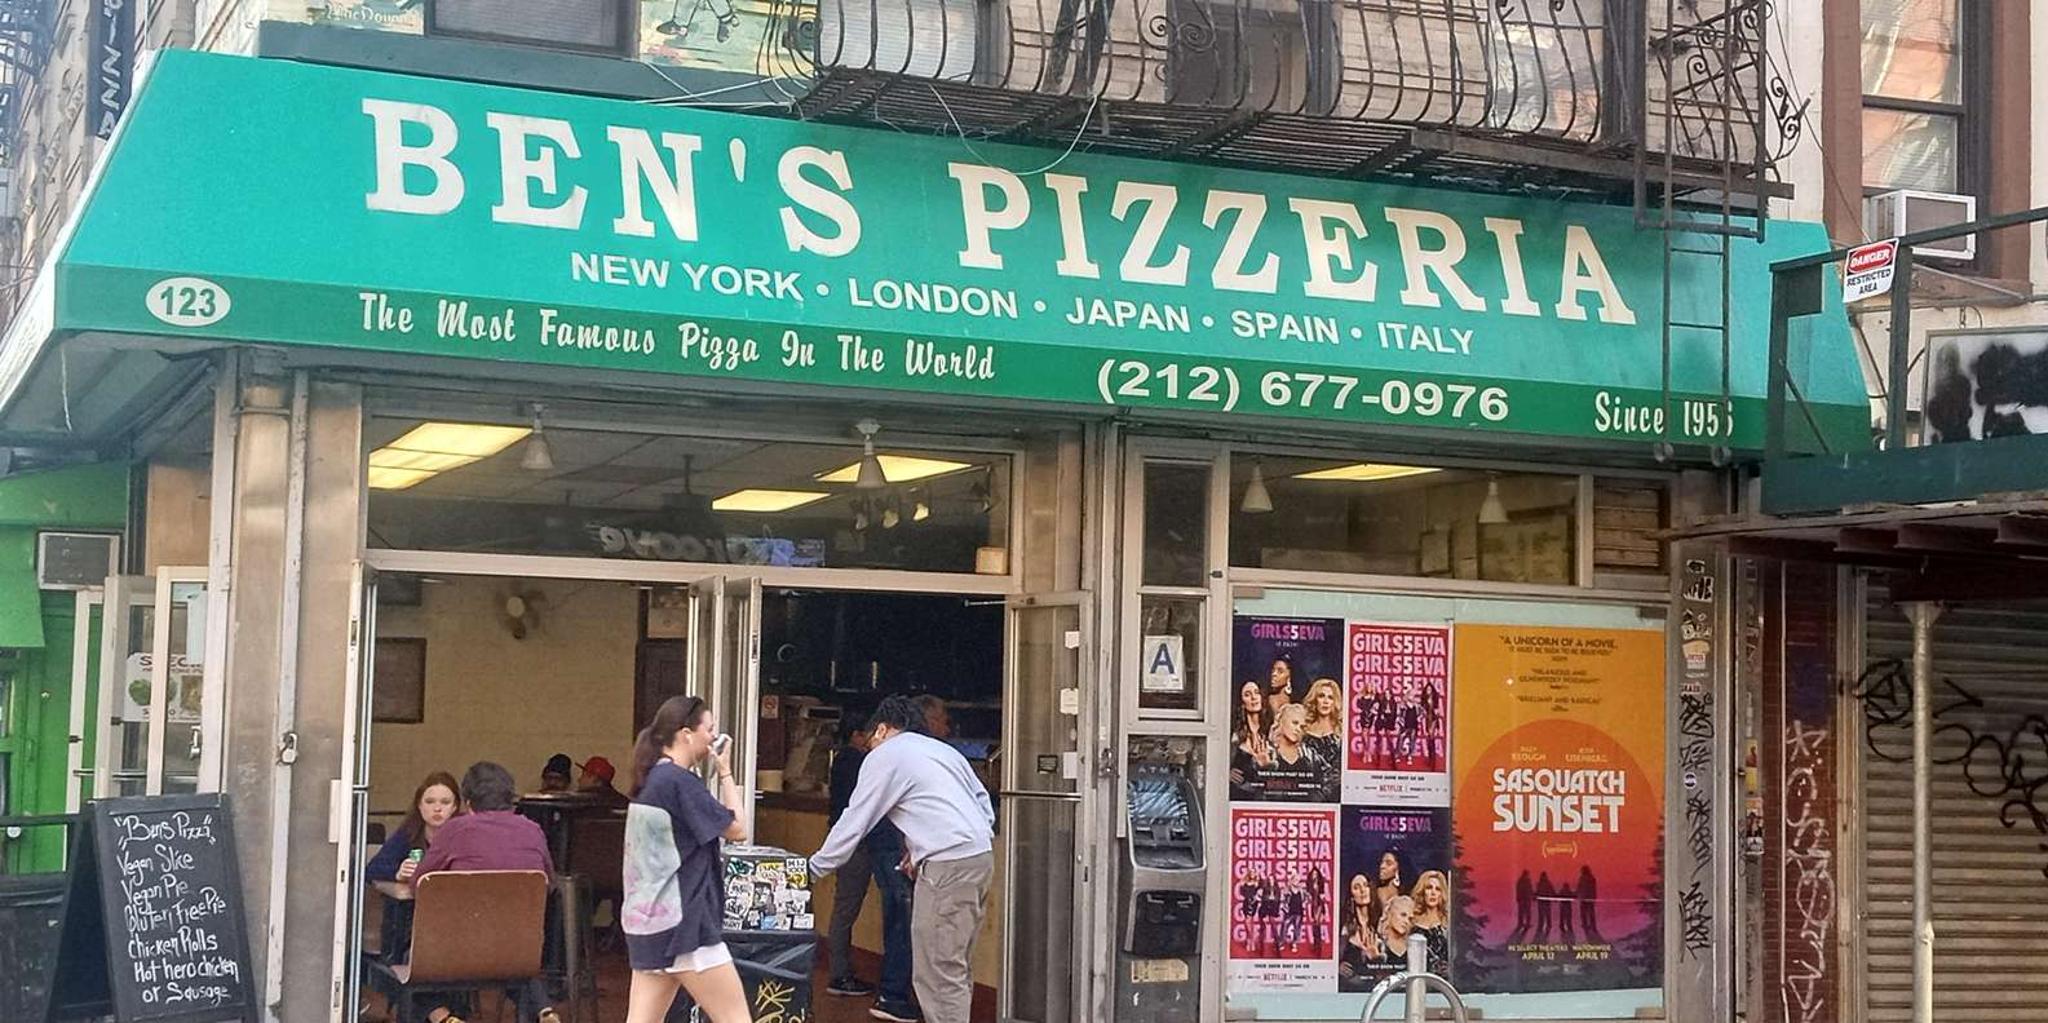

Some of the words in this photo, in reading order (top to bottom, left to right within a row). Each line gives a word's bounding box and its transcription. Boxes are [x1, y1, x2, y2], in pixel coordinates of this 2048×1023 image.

[362, 98, 861, 257] BEN'S
[948, 162, 1635, 325] PIZZERIA
[1849, 247, 1891, 268] DANGER
[1846, 269, 1892, 287] RESTRICTED
[1859, 282, 1878, 295] AREA
[160, 285, 217, 318] 123
[570, 250, 669, 288] NEW
[682, 261, 803, 301] YORK
[848, 278, 1019, 320] LONDON
[1066, 297, 1191, 333] JAPAN
[1232, 309, 1341, 345] SPAIN
[1376, 320, 1475, 356] ITALY
[359, 292, 414, 333] The
[436, 299, 516, 343] Most
[540, 308, 656, 355] Famous
[678, 321, 760, 371] Pizza
[781, 330, 816, 368] In
[838, 334, 885, 372] The
[905, 338, 996, 381] World
[1098, 358, 1241, 412] (212)
[1260, 369, 1510, 422] 677-0976
[1594, 391, 1664, 434] Since
[1251, 623, 1326, 641] GIRLS5EVA
[1352, 632, 1446, 656] GIRLS5EVA
[1514, 636, 1558, 647] UNICORN
[1561, 638, 1574, 647] OF
[1576, 638, 1583, 646] A
[1149, 642, 1176, 675] A
[1352, 653, 1446, 676] GIRLS5EVA
[1492, 767, 1626, 795] SASQUATCH
[1360, 815, 1432, 832] GIRLS5EVA
[1492, 795, 1626, 833] SUNSET
[1235, 818, 1332, 839] GIRLS5EVA
[1234, 838, 1332, 860] GIRLS5EVA
[116, 850, 154, 886] Vegan
[154, 843, 195, 873] Slice
[120, 879, 162, 913] Vegan
[177, 925, 219, 961] Rolls
[1522, 951, 1545, 960] APRIL
[1576, 952, 1599, 961] APRIL
[133, 959, 162, 983] Hot
[162, 957, 197, 981] hero
[142, 986, 161, 1003] or
